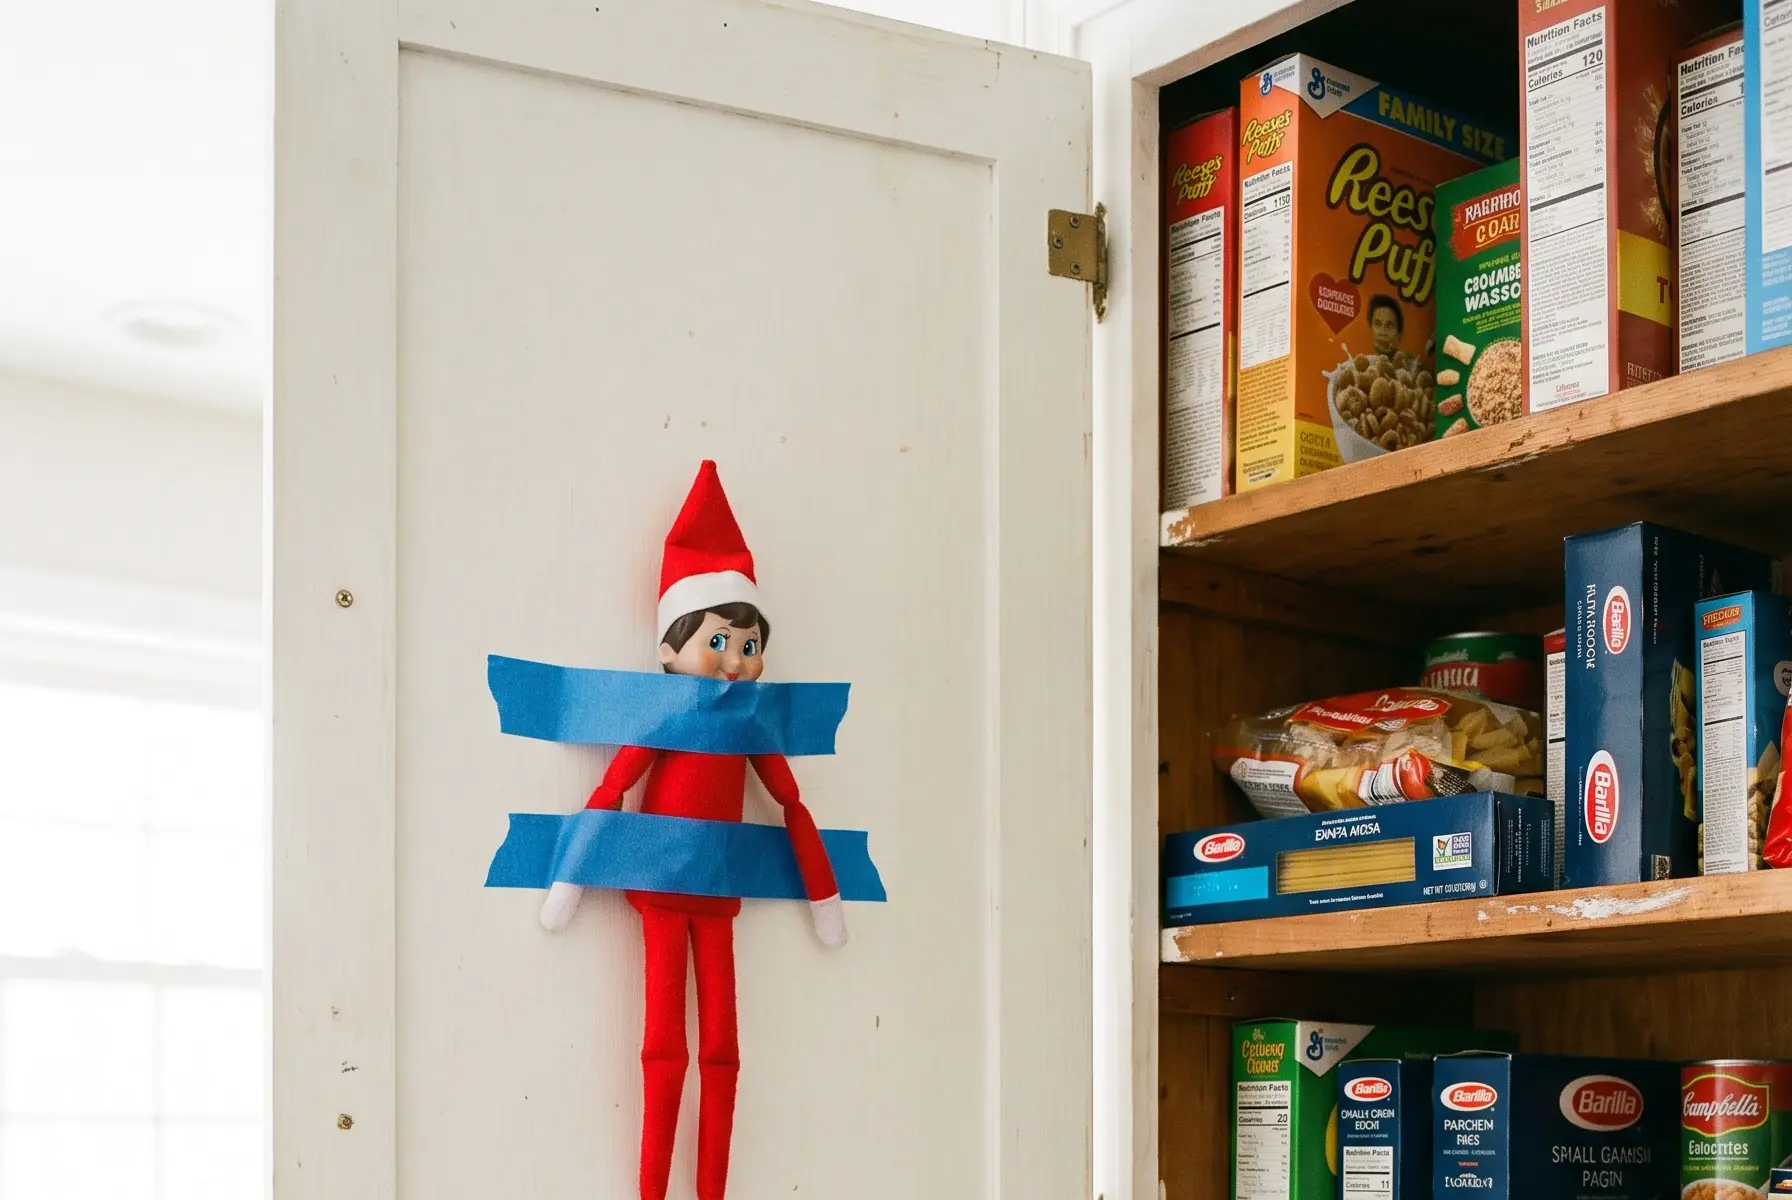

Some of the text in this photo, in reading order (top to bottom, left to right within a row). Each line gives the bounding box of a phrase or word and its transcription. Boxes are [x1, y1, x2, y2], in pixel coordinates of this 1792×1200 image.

[1573, 12, 1603, 30] Facts
[1582, 50, 1603, 66] 120
[1378, 90, 1506, 162] FAMILY SIZE
[1578, 1089, 1637, 1114] Barilla
